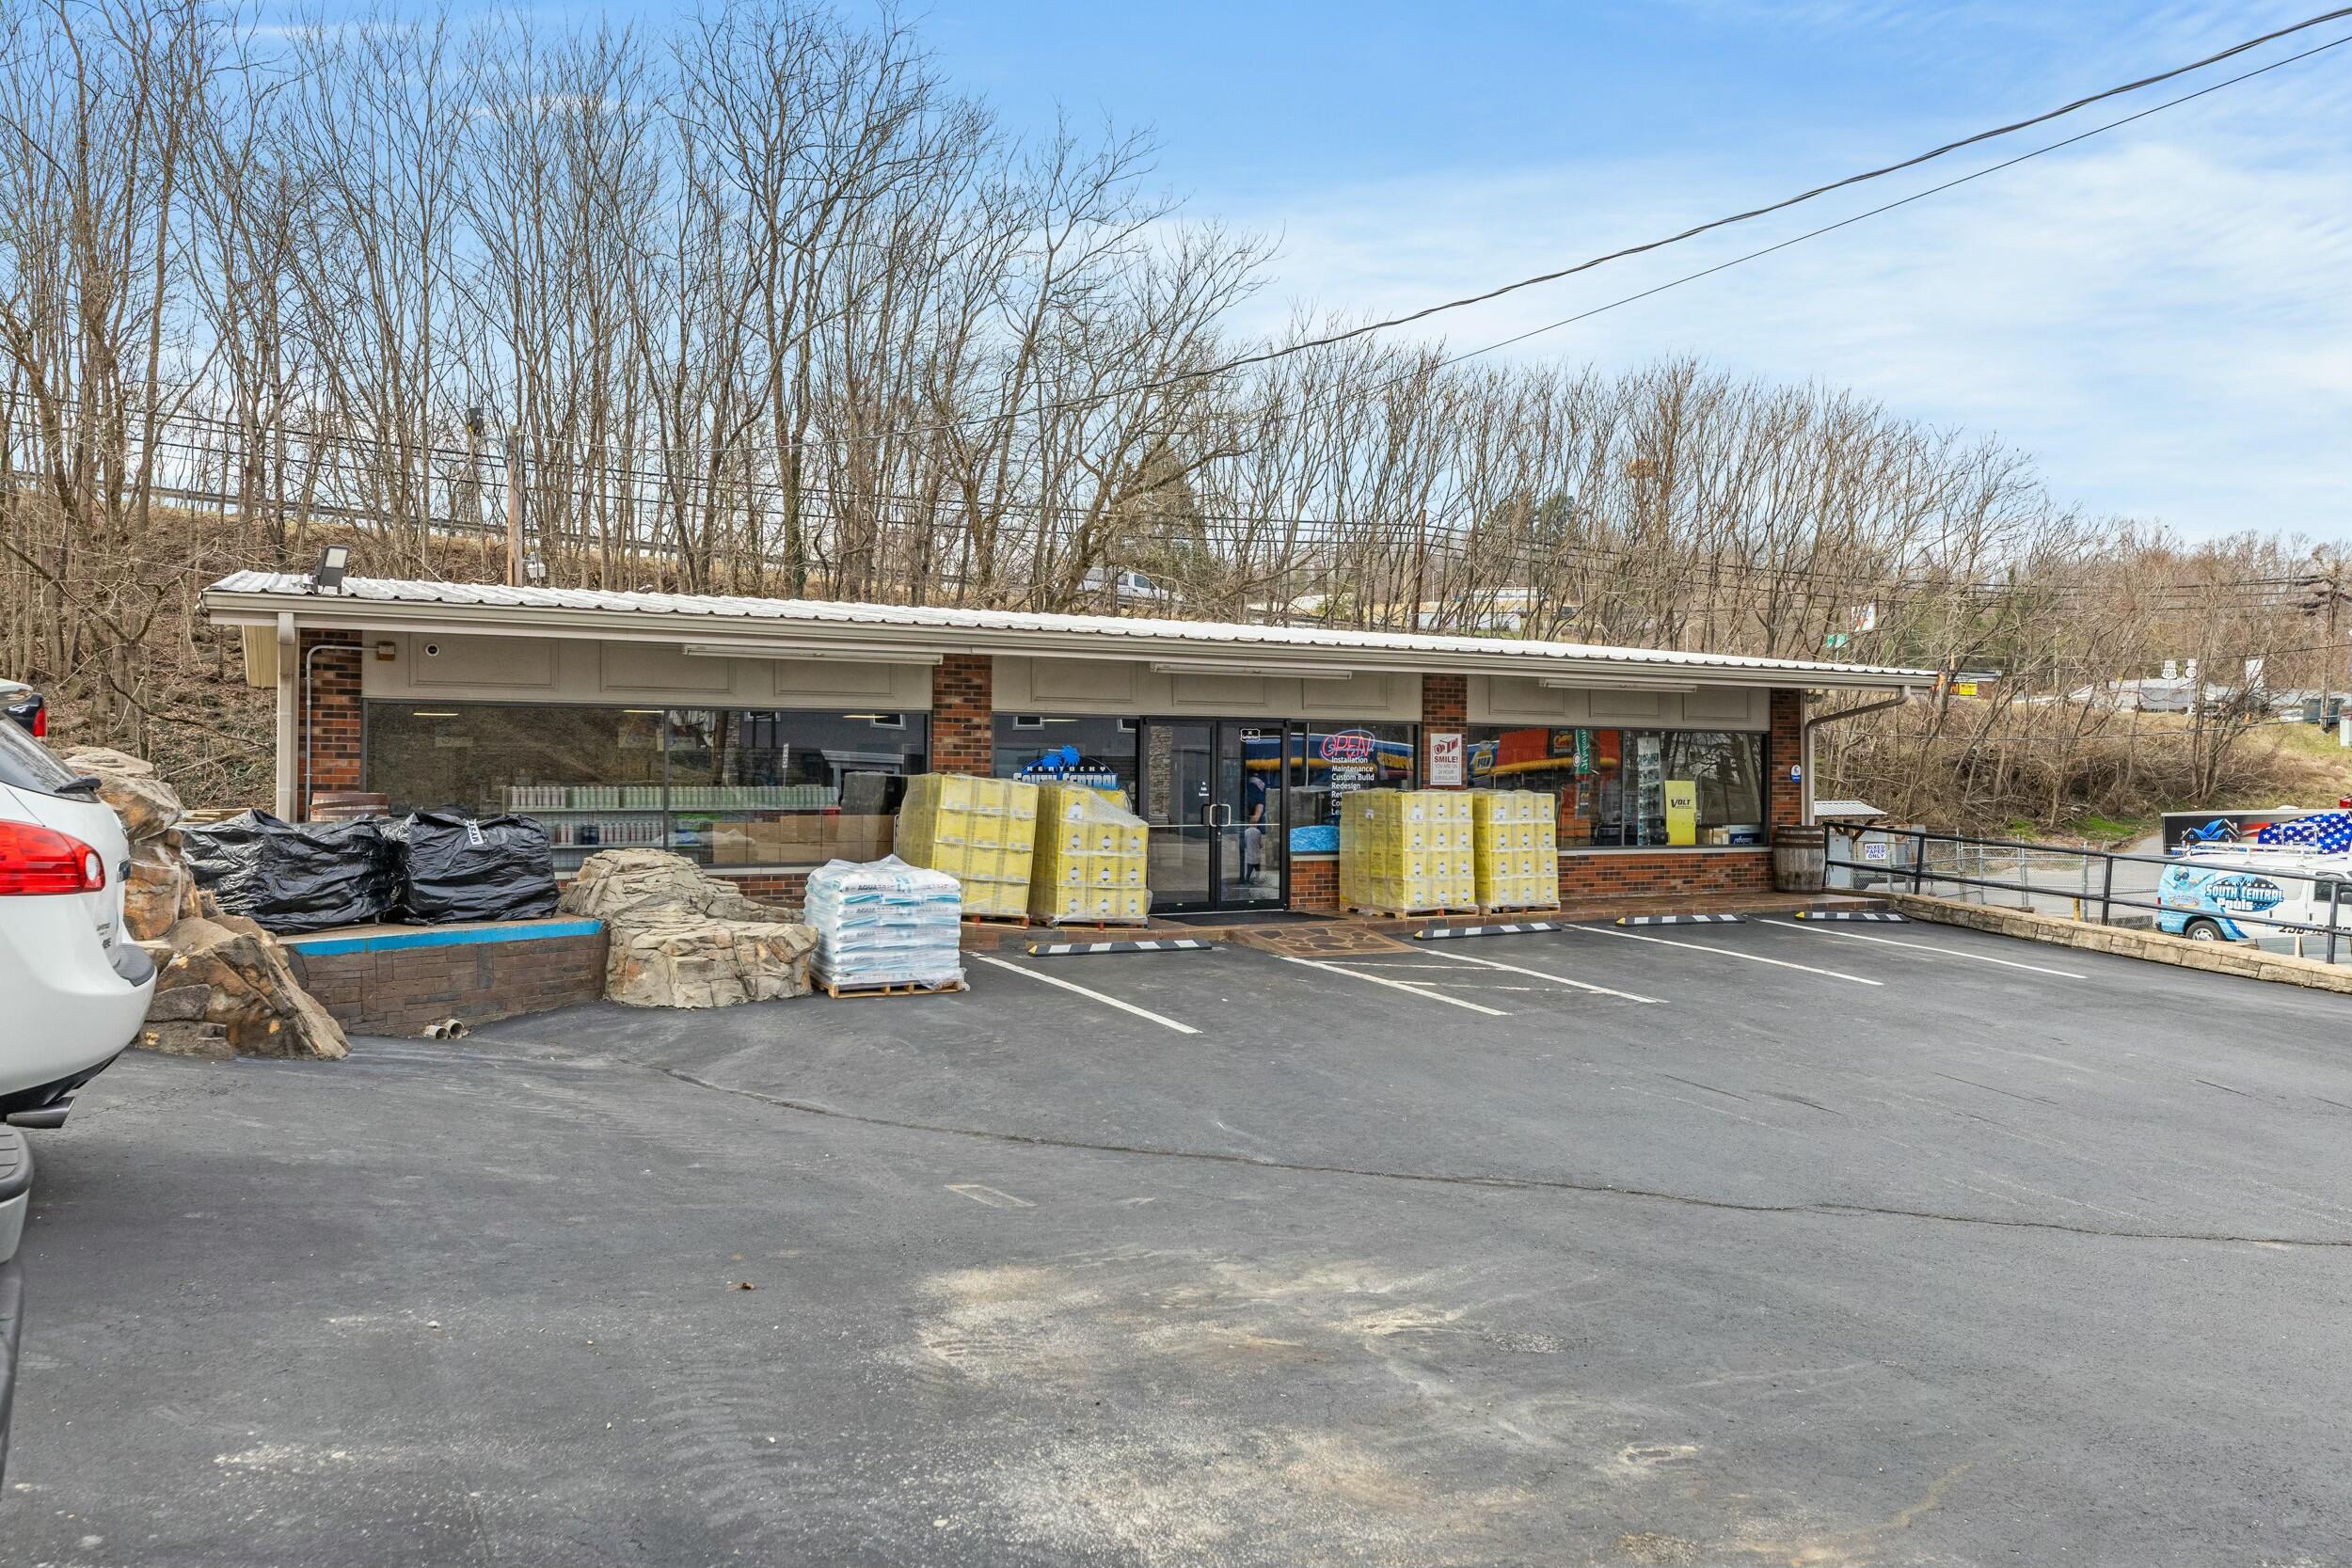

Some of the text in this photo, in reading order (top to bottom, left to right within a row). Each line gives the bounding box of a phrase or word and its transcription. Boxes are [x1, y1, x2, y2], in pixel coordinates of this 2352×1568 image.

[1323, 736, 1372, 757] OPEN
[1331, 782, 1361, 790] Redesign
[1671, 799, 1692, 808] VOLT
[2205, 884, 2284, 902] SOUTH CENTRAL
